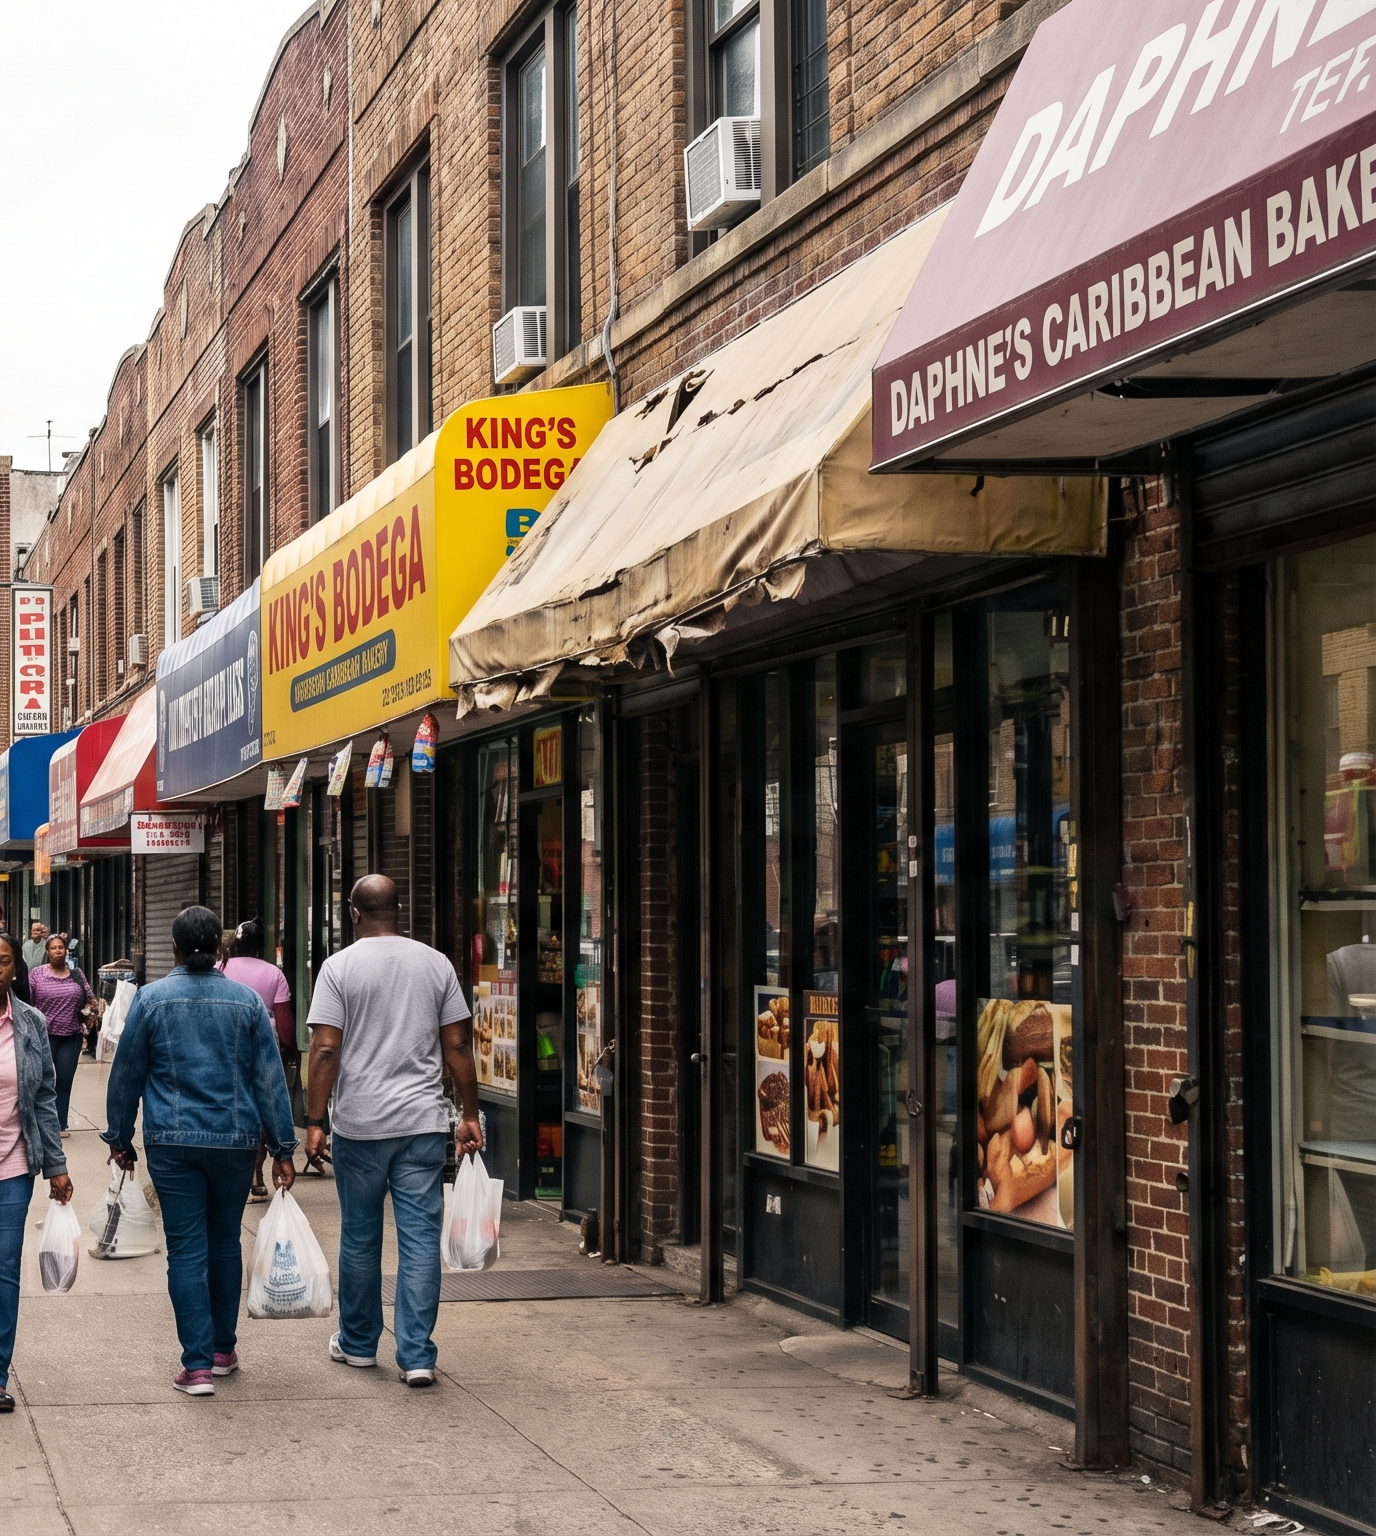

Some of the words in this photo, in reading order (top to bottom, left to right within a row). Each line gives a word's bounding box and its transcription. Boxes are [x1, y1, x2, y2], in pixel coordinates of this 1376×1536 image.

[890, 317, 1033, 437] DAPHNE'S
[1042, 209, 1252, 367] CARIBBEAN
[466, 417, 577, 449] KING'S
[268, 569, 327, 675] KING'S
[332, 504, 426, 644] BODEGA
